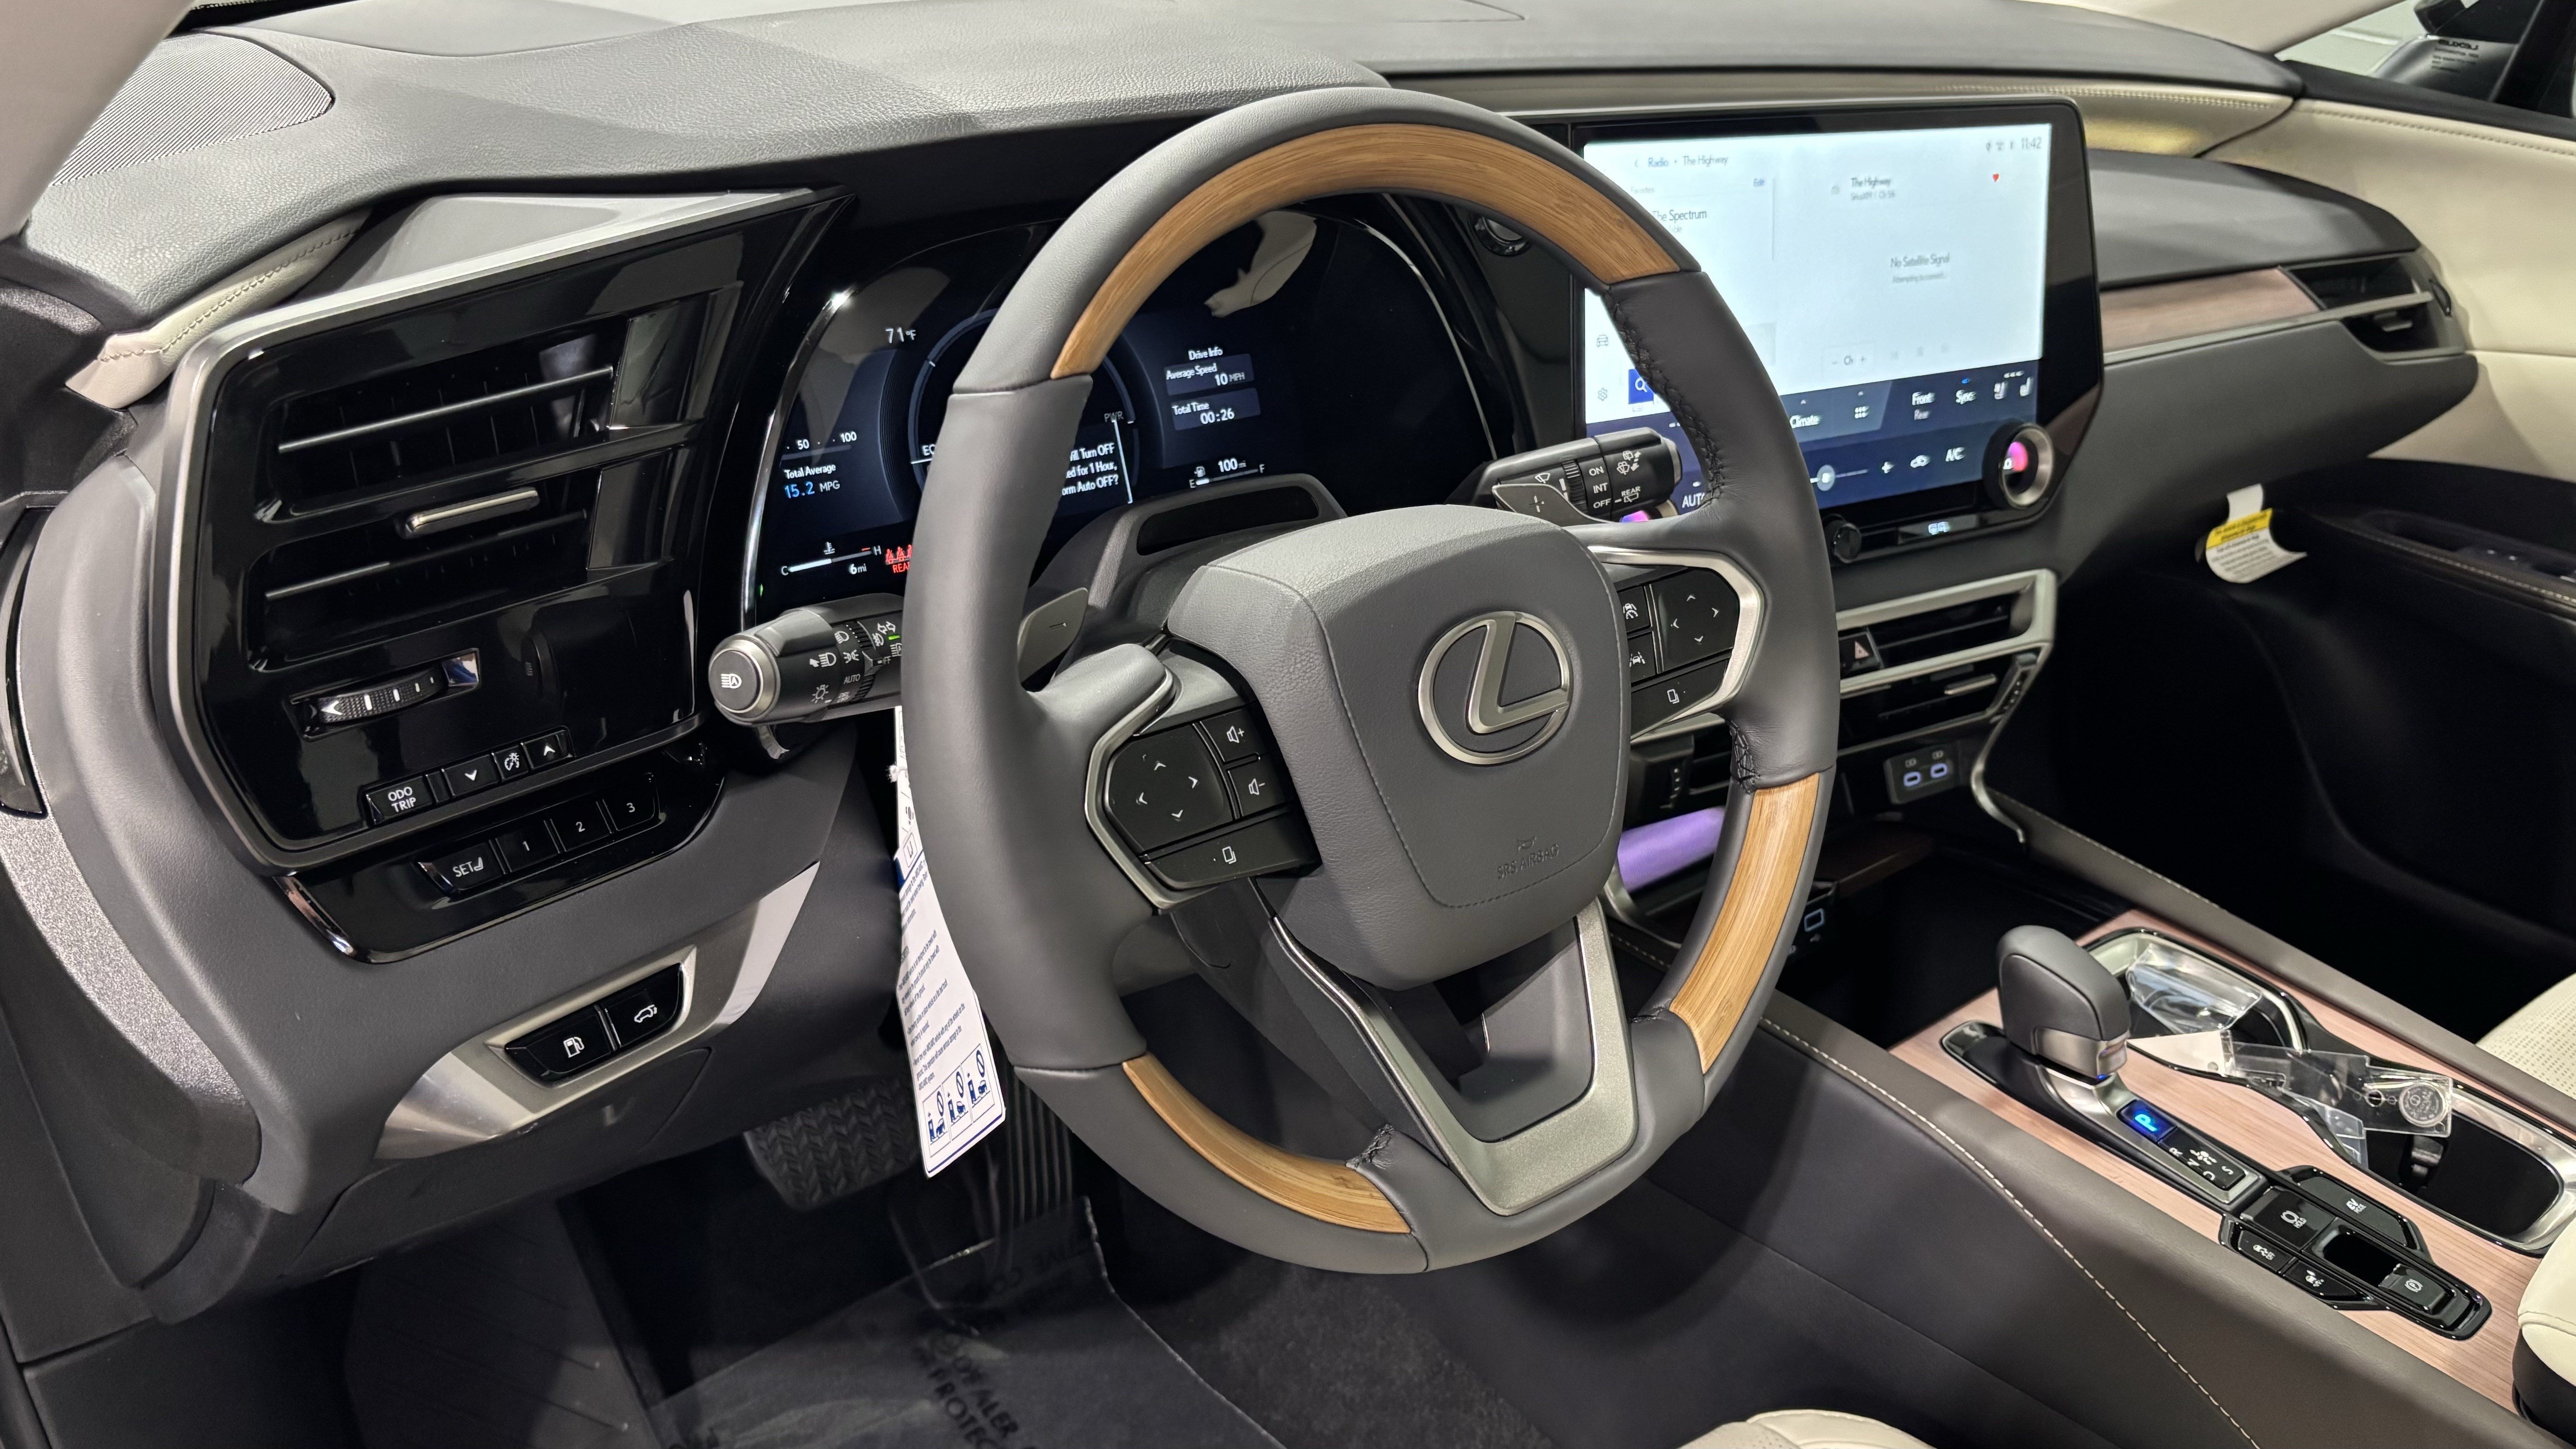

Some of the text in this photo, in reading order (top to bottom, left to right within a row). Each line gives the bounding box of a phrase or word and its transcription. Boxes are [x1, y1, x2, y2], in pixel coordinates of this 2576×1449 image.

[1648, 155, 1728, 167] Radio The Highway
[1851, 177, 1863, 187] The
[1669, 209, 1707, 223] Spectrum
[1891, 252, 1950, 268] No Satellite Signal
[1188, 346, 1223, 360] Drive Info
[1166, 363, 1218, 380] Average Speed
[1215, 373, 1228, 386] 10
[1912, 391, 1935, 405] Front
[1172, 401, 1210, 415] Total Time
[1104, 411, 1124, 422] PWR
[1200, 408, 1235, 424] 00:26
[1789, 414, 1821, 428] Climate
[797, 431, 857, 450] 50 100
[922, 444, 935, 456] EC
[1070, 442, 1115, 461] ill Turn OFF
[784, 464, 837, 479] Total Average
[1066, 460, 1118, 478] ed for 1 Hour,
[1259, 464, 1265, 473] F
[1589, 466, 1604, 477] ON
[784, 480, 840, 498] 15.2 MPG
[1062, 474, 1119, 496] orm Auto OFF?
[1189, 479, 1196, 488] E
[1593, 482, 1608, 493] INT
[1621, 486, 1641, 497] REAR
[1593, 498, 1611, 509] OFF
[874, 545, 882, 556] H
[782, 566, 789, 576] C
[892, 562, 910, 573] REA
[843, 674, 861, 685] AUTO
[388, 787, 413, 801] ODO
[391, 797, 416, 813] TRIP
[626, 802, 635, 813] 3
[575, 822, 585, 833] 2
[522, 841, 530, 851] 1
[1497, 844, 1559, 879] SRS AIRBAG
[452, 861, 474, 878] SET
[2134, 1113, 2157, 1132] P
[2169, 1147, 2183, 1157] R
